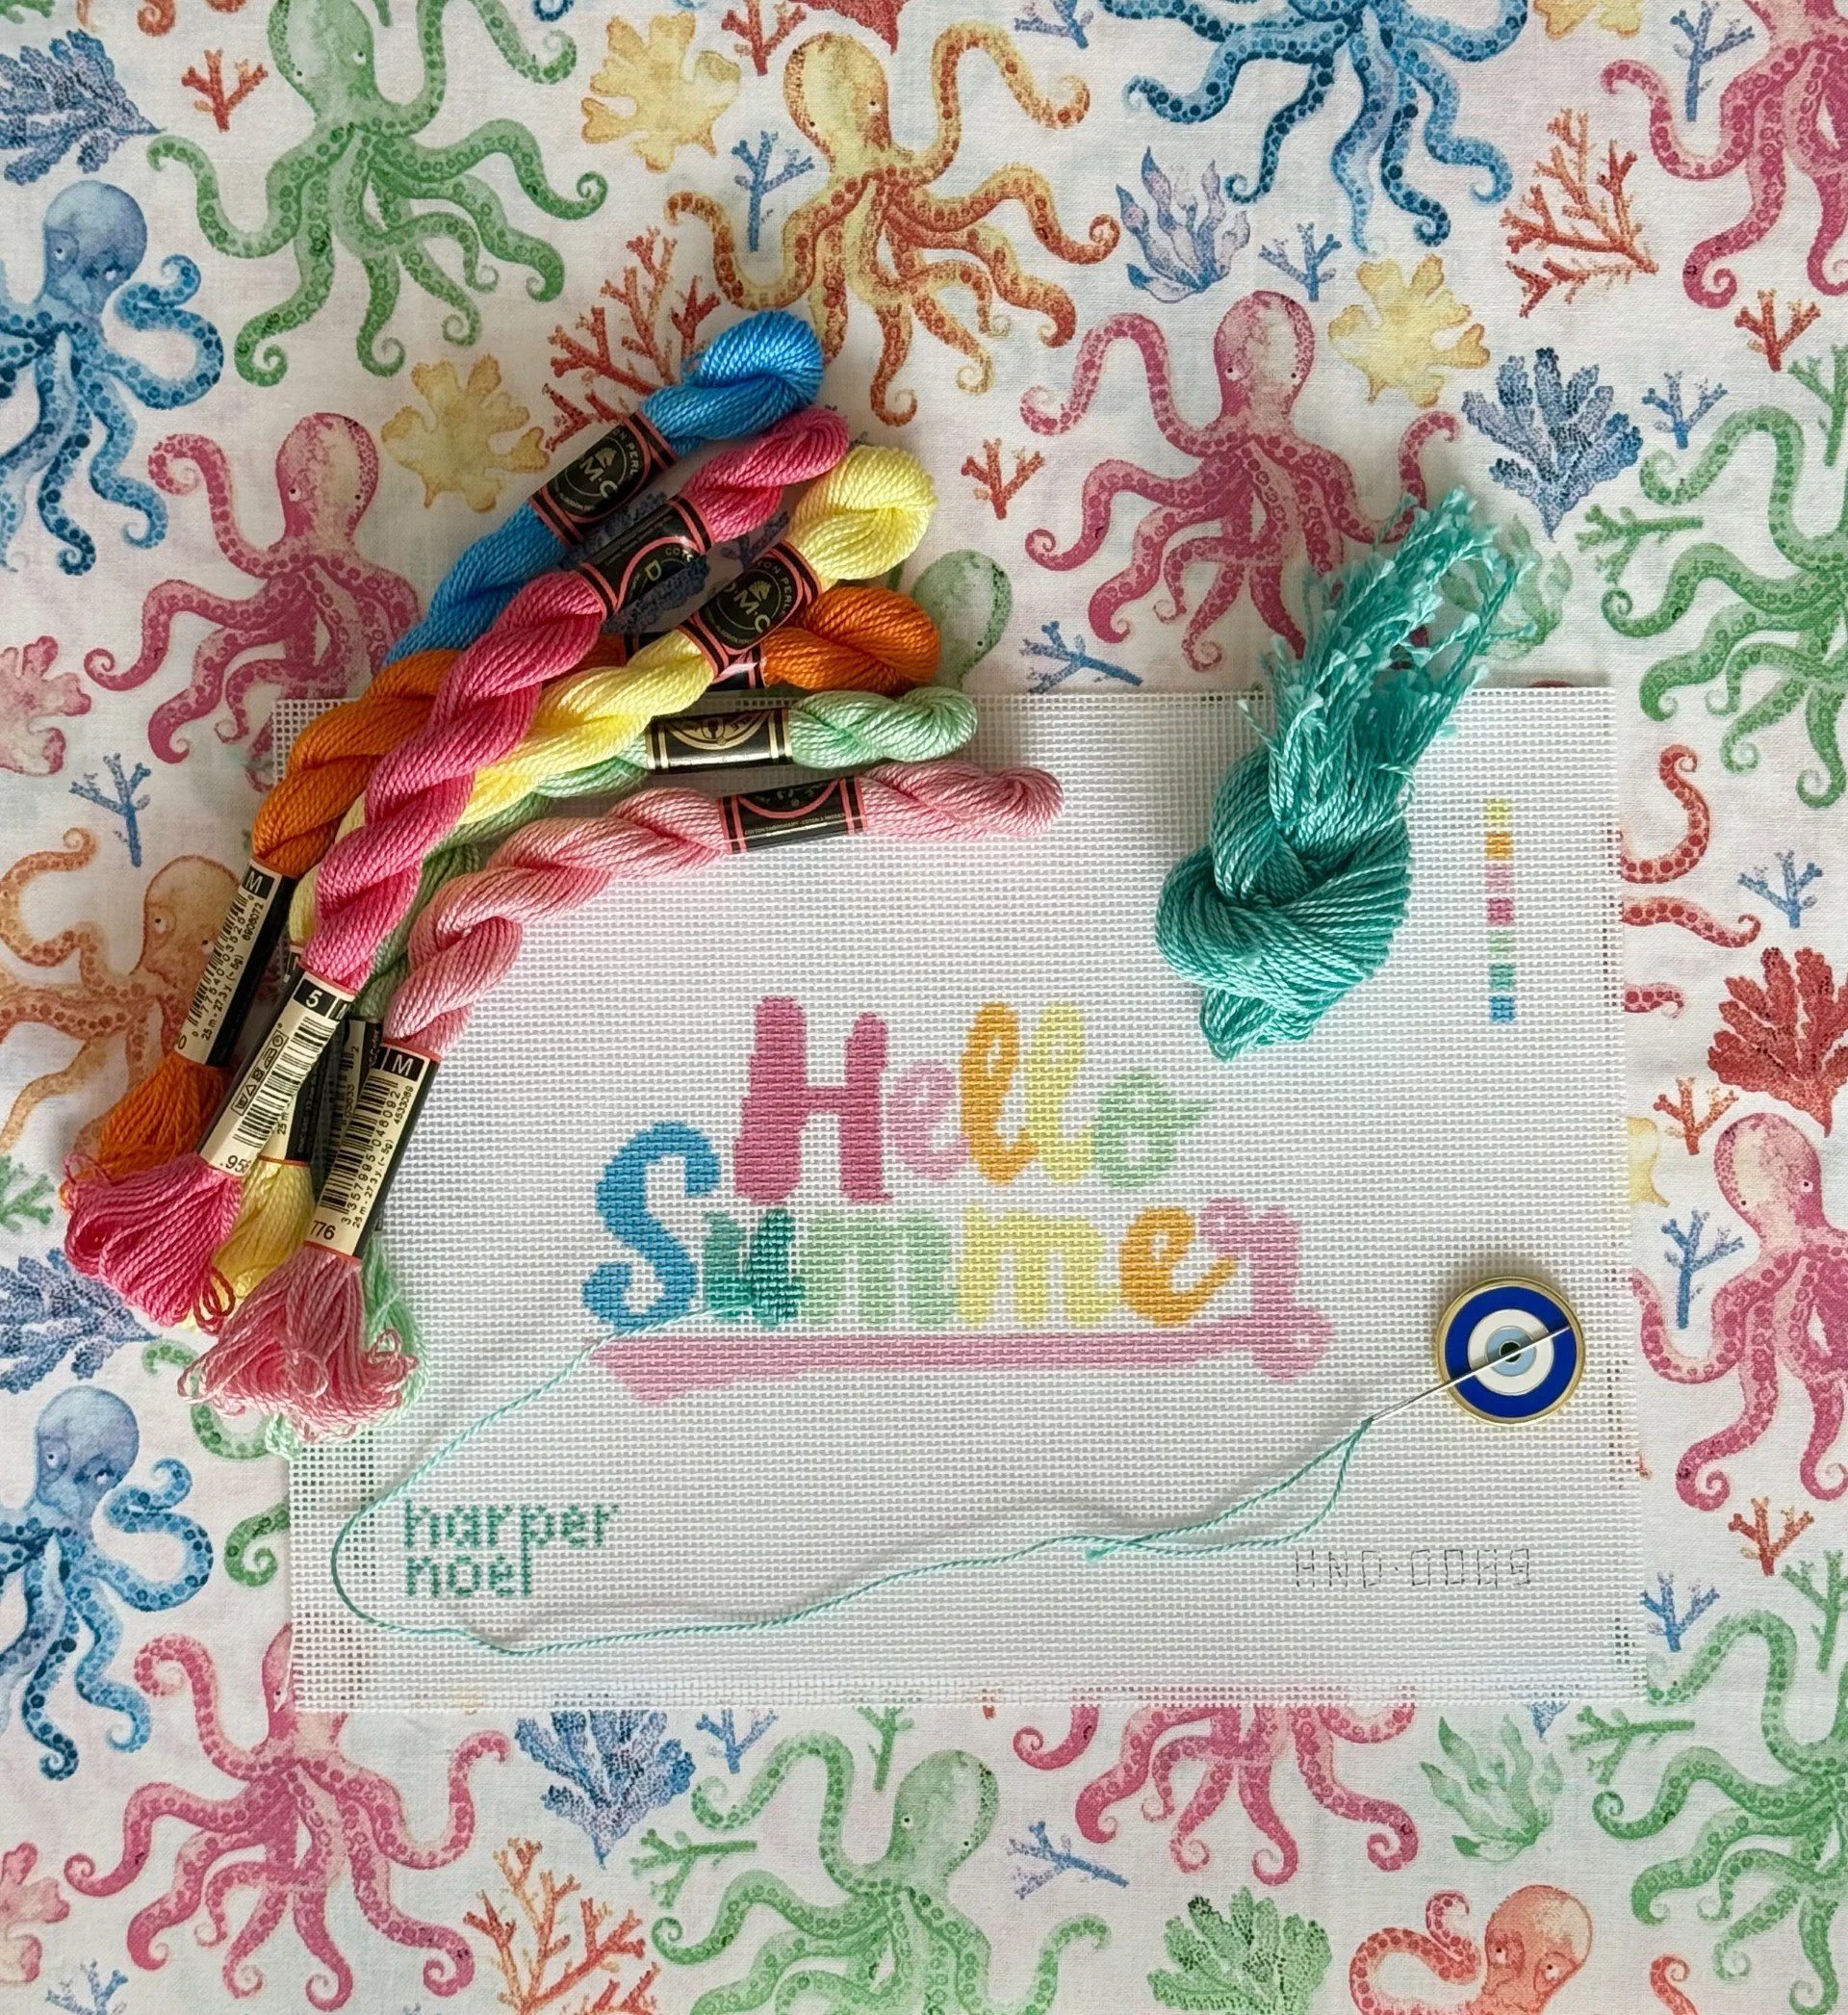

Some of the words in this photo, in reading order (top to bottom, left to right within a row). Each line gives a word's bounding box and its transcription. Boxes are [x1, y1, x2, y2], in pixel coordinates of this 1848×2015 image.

[245, 870, 264, 894] M
[305, 989, 323, 1008] 5
[392, 1053, 414, 1077] M
[733, 995, 1215, 1205] Hello
[581, 1121, 1303, 1330] Summer
[404, 1498, 621, 1552] harper
[404, 1552, 533, 1598] noel
